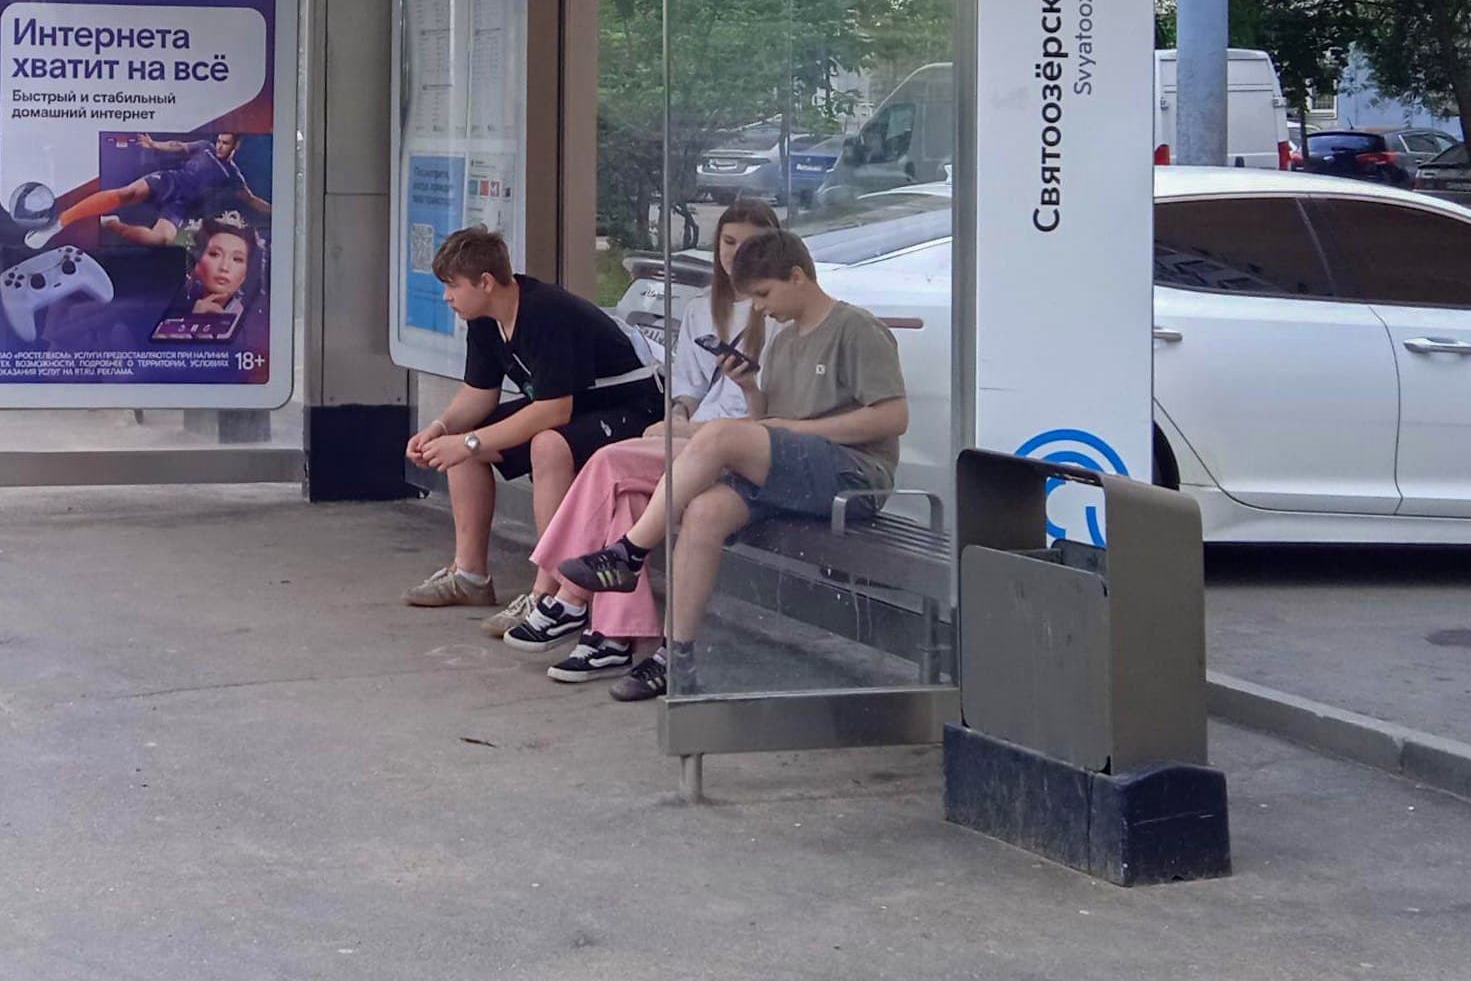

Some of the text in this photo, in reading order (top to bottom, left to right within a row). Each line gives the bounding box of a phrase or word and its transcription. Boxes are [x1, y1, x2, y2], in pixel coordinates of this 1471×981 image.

[13, 18, 190, 55] Интернета
[12, 54, 230, 82] хватит на всё
[12, 90, 176, 105] Быстрый и стабильный
[12, 107, 155, 122] домашний интернет
[234, 351, 266, 370] 18+
